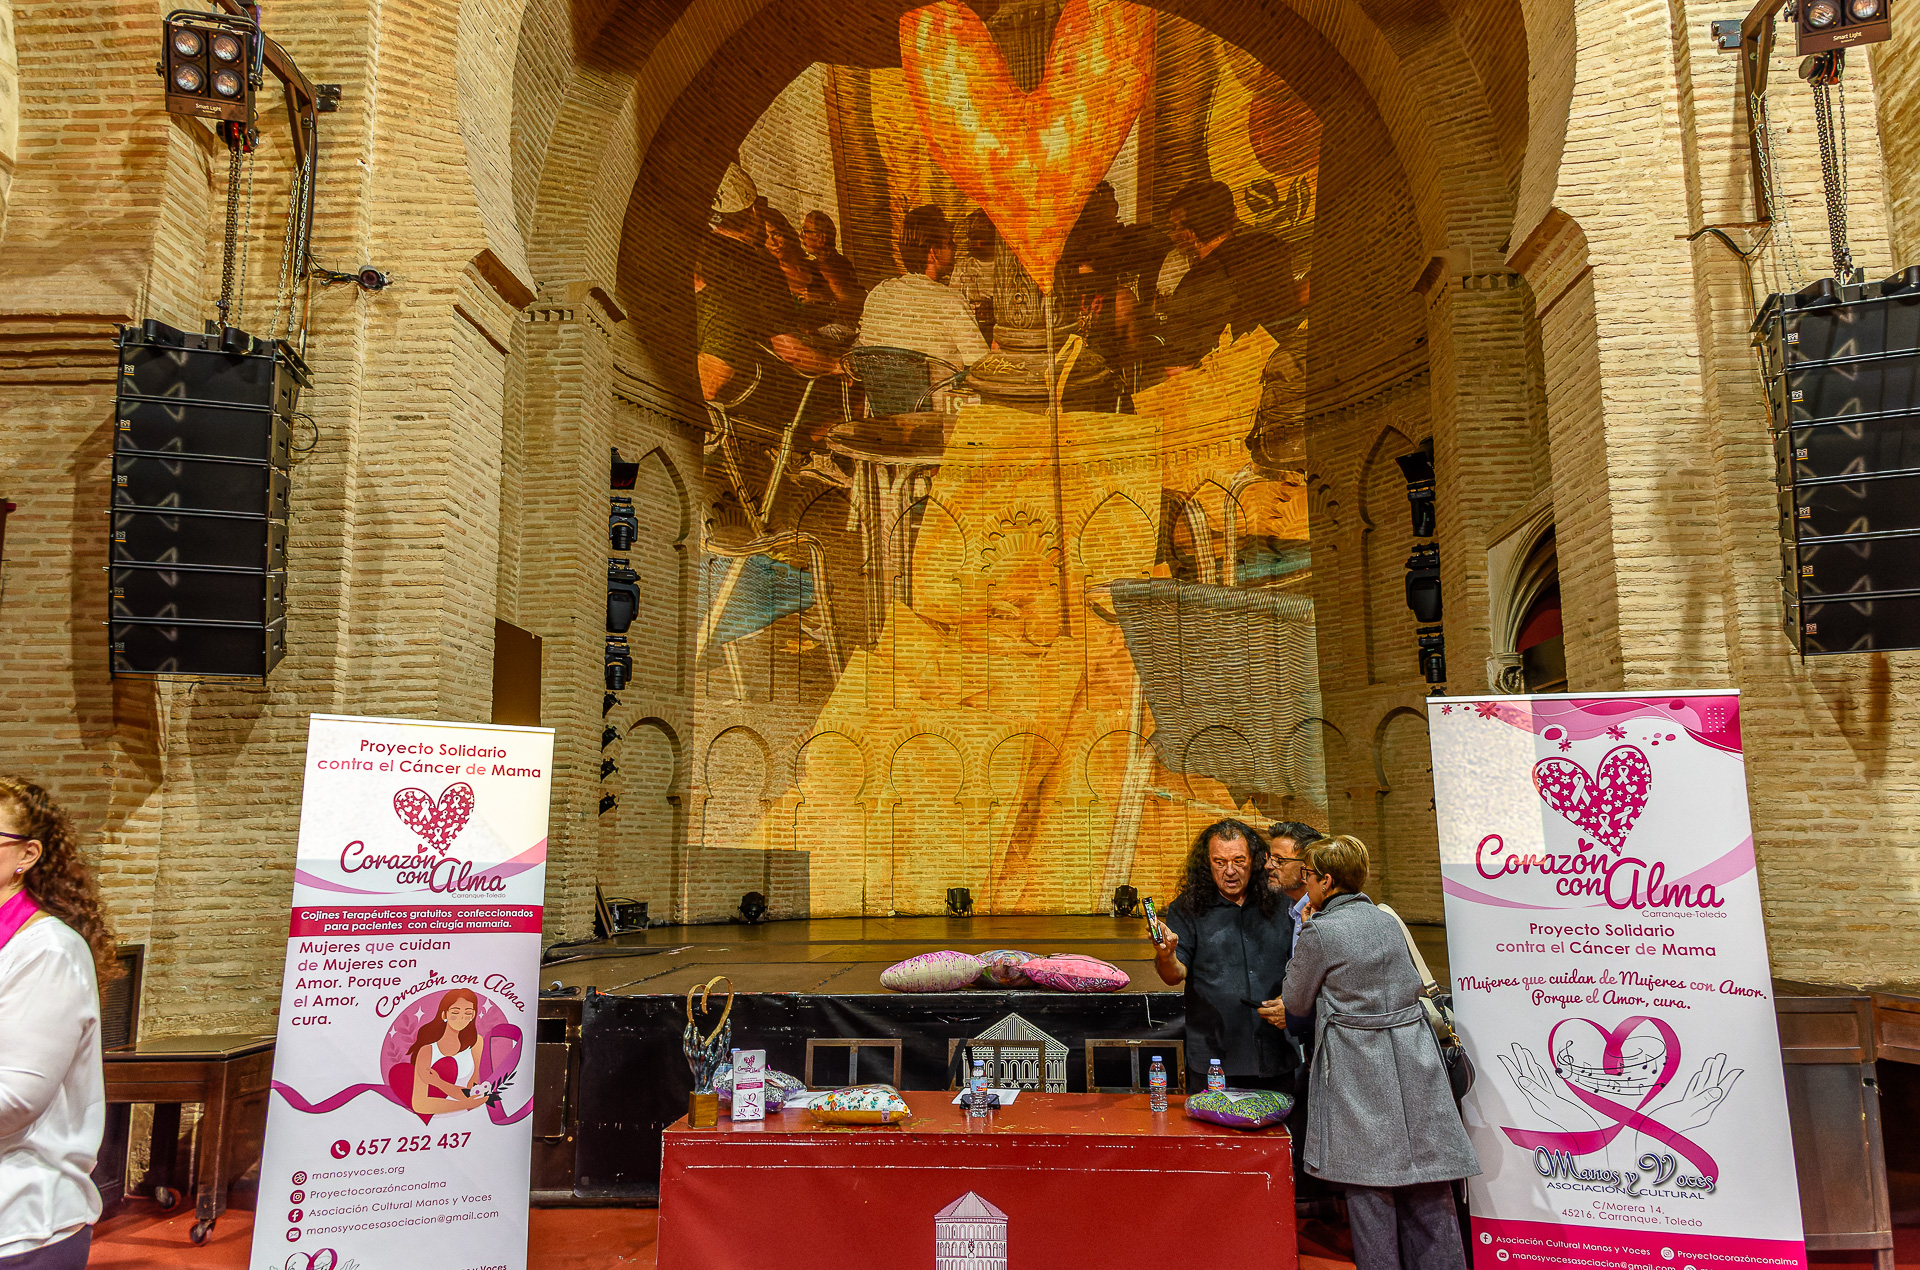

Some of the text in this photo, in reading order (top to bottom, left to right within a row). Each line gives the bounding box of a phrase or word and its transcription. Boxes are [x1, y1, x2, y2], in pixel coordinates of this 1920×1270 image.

[361, 740, 507, 759] Proyecto Solidario
[318, 758, 541, 778] contra el Cáncer de Mama
[341, 840, 435, 873] Corazón
[1475, 834, 1610, 879] Corazón
[397, 858, 506, 893] con Alma
[1556, 857, 1724, 910] con Alma
[301, 909, 534, 921] Cojines Terapéuticos gratuitos confeccionados
[1642, 910, 1727, 919] Carranque-Toledo
[324, 920, 512, 932] para pacientes con cirugía mamaria.
[1529, 923, 1675, 937] Proyecto Solidario
[300, 939, 451, 956] Mujeres que cuidan
[1496, 939, 1716, 957] contra el Cáncer de Mama
[298, 958, 417, 973] de Mujeres con
[296, 976, 401, 990] Amor. Porque
[1458, 969, 1767, 999] Mujeres que cuidan de Mujeres con Amor.
[294, 996, 359, 1008] el Amor,
[376, 970, 526, 1018] Corazón con Alma
[1532, 990, 1691, 1010] Porque el Amor, cura.
[292, 1015, 332, 1026] cura.
[356, 1132, 472, 1156] 657 252 437
[312, 1165, 405, 1180] manosyvoces.org
[1533, 1146, 1716, 1196] Manos y Voces
[310, 1180, 447, 1200] Proyectocorazónconalma
[1547, 1182, 1705, 1200] ASOCIACIÓN CULTURAL
[309, 1193, 492, 1218] Asociación Cultural Manos y Voces
[1593, 1201, 1646, 1214] C/Morera
[306, 1210, 499, 1236] manosyvocesasociacion@gmail.com
[1665, 1217, 1703, 1227] Toledo
[1496, 1235, 1650, 1256] Asociación Cultural Manos y Voces
[1677, 1250, 1798, 1266] Proyectocorazónconalma
